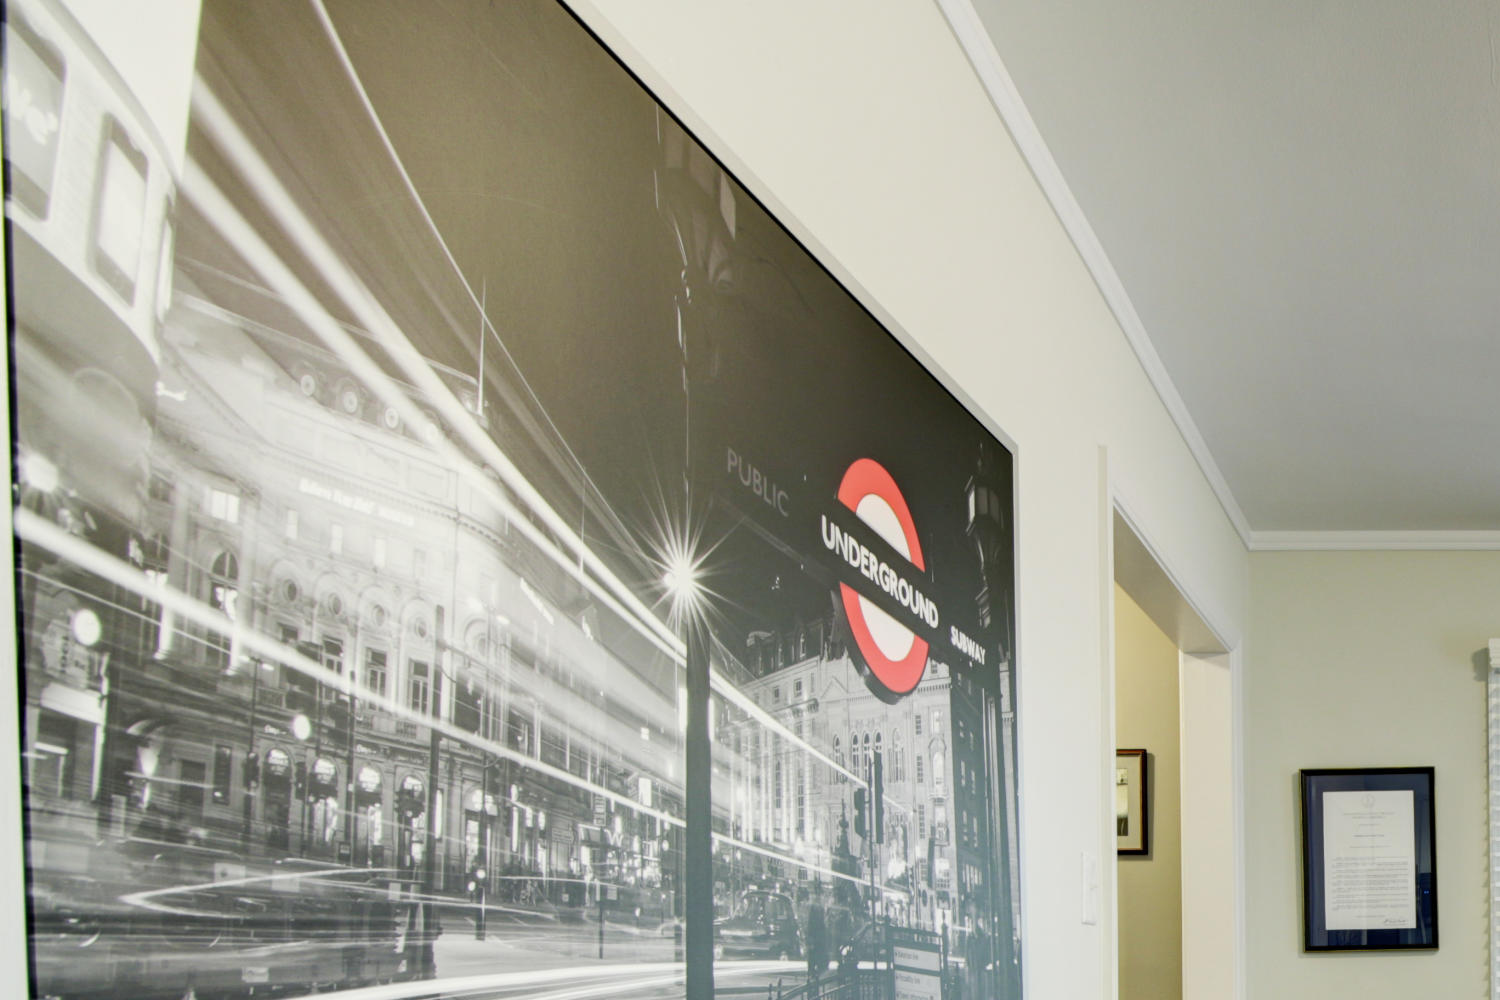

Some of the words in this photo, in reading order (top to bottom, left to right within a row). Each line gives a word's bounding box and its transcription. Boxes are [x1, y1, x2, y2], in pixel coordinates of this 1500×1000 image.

[727, 447, 789, 518] PUBLIC
[821, 513, 939, 630] UNDERGROUND
[950, 625, 986, 666] SUBWAY
